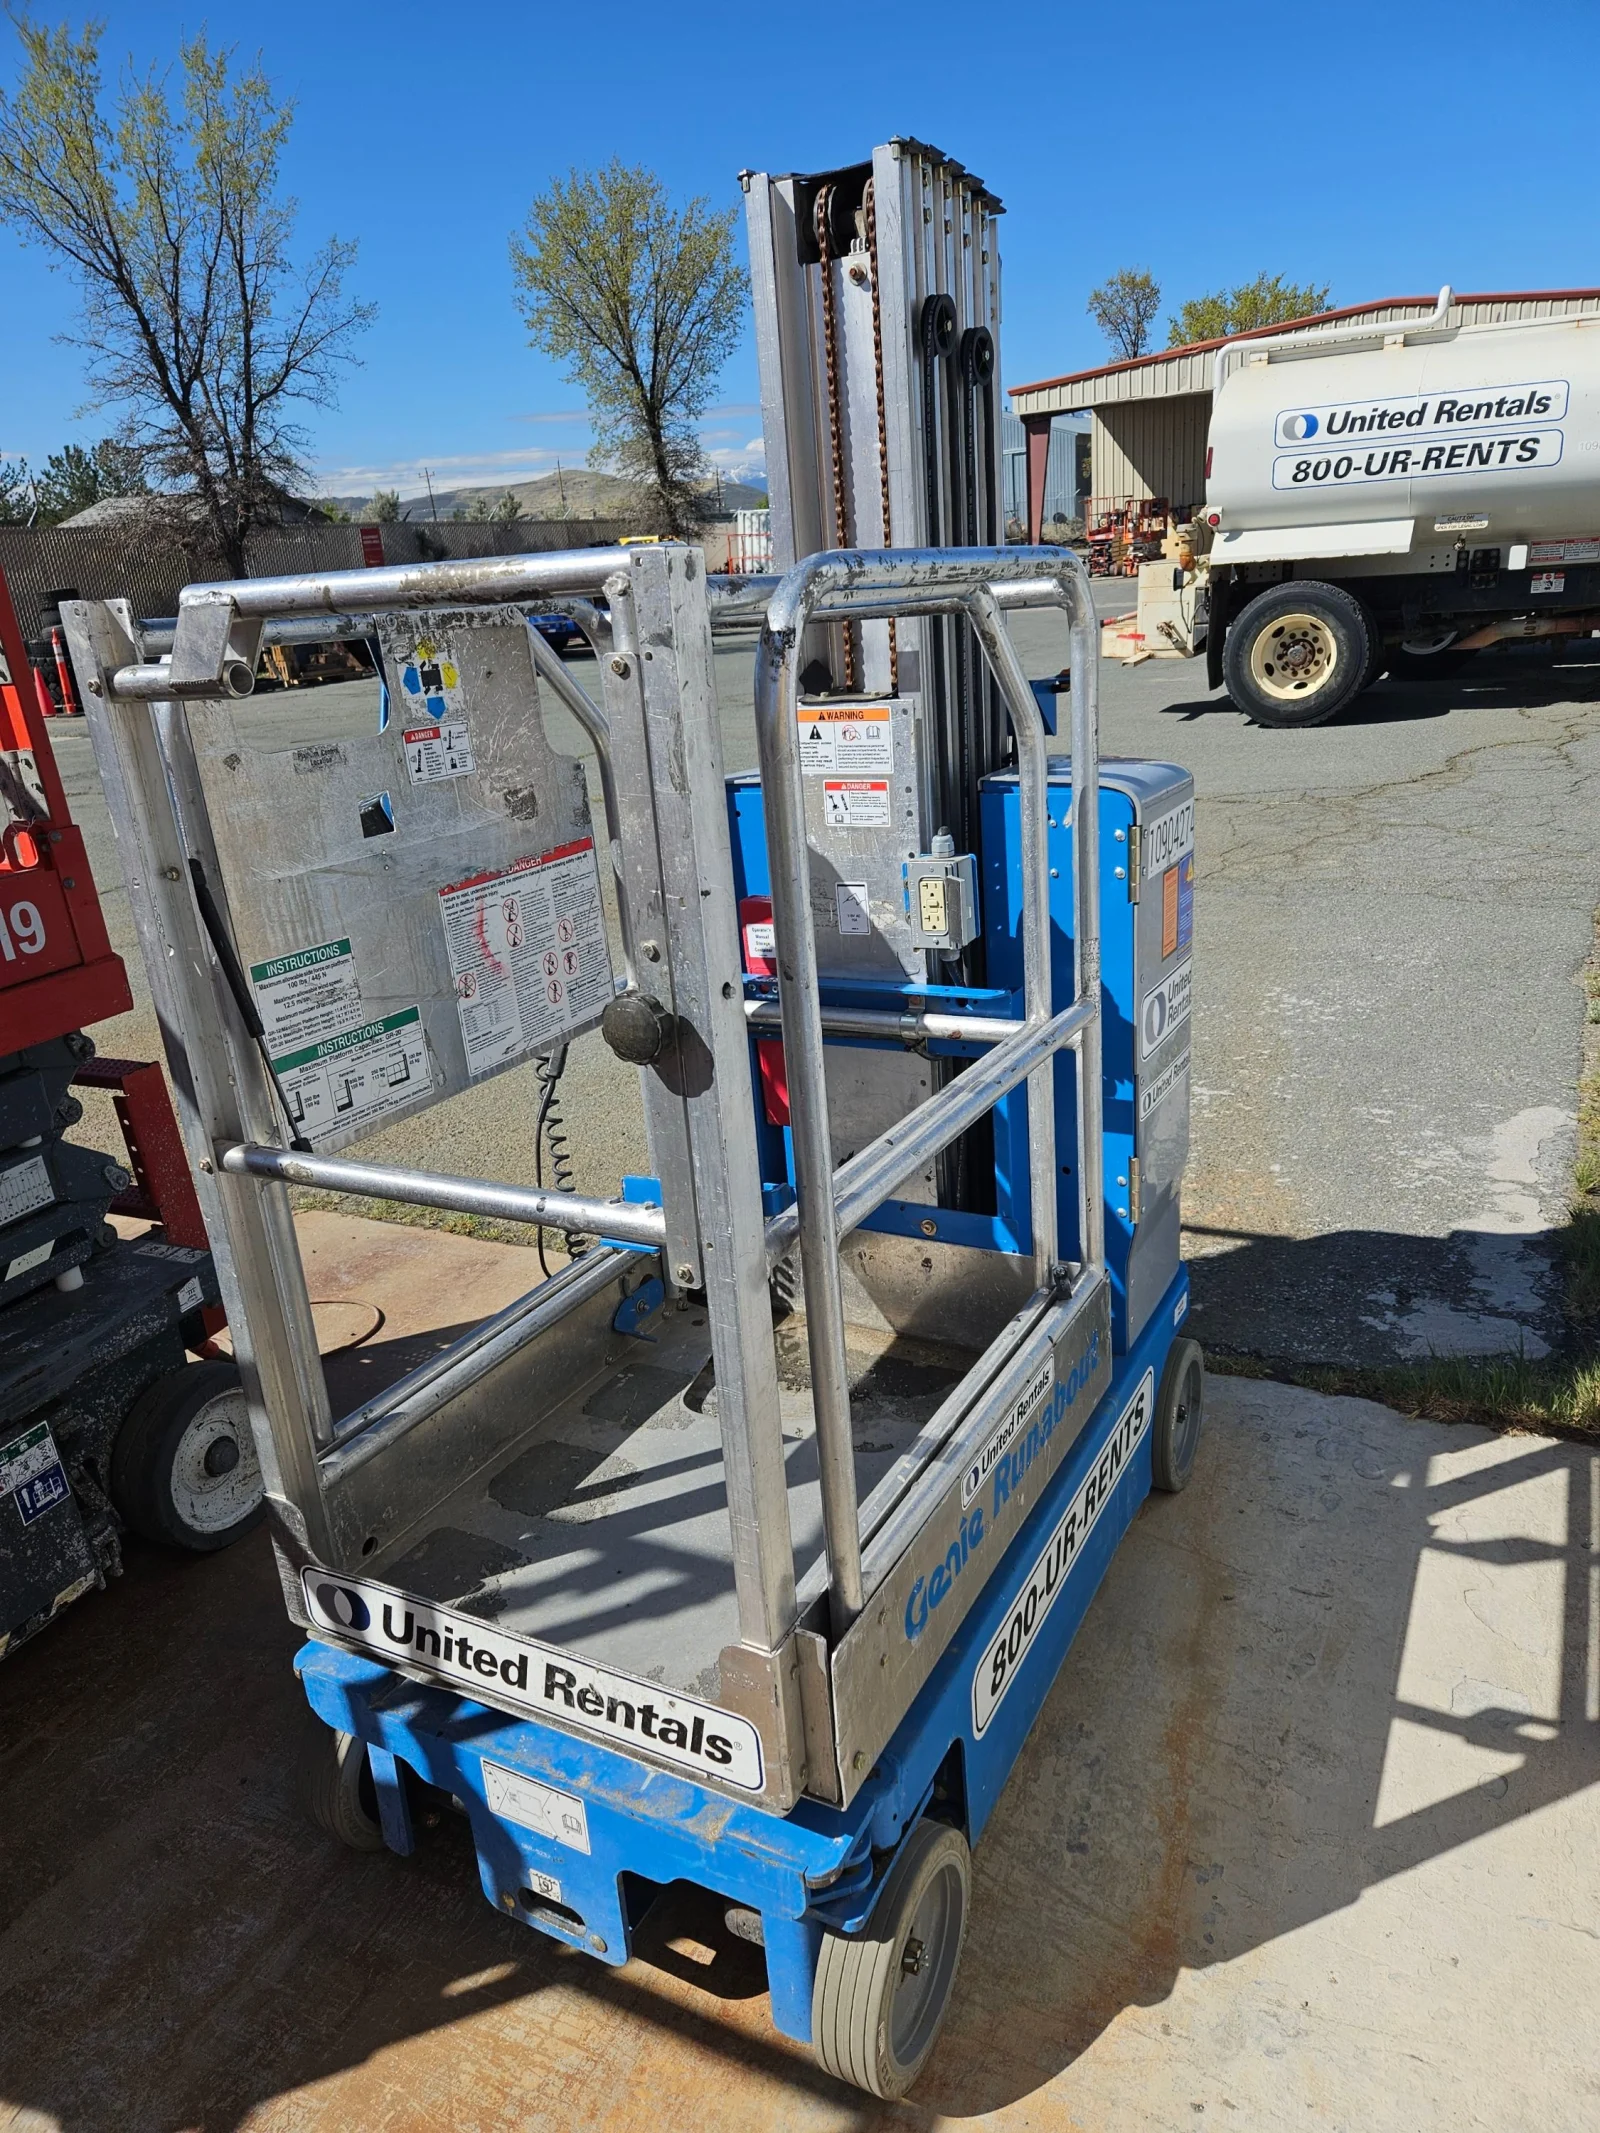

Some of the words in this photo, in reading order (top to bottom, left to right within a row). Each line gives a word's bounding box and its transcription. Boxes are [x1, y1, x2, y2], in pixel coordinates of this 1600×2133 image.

[1326, 402, 1428, 436] United
[1433, 390, 1552, 424] Rentals
[1291, 437, 1541, 483] 800-UR-RENTS
[826, 711, 864, 720] WARNING
[416, 730, 434, 740] DANGER
[508, 858, 542, 874] DANGER
[266, 944, 340, 977] INSTRUCTIONS
[259, 980, 282, 991] Maximum
[282, 972, 303, 984] allowable
[303, 969, 313, 977] side
[313, 966, 325, 974] force
[288, 981, 298, 989] 100
[299, 978, 307, 986] lbs
[312, 973, 321, 981] 445
[1168, 970, 1192, 1002] United
[274, 993, 296, 1005] Maximum
[297, 986, 318, 997] allowable
[284, 1001, 296, 1009] 12.5
[276, 1012, 298, 1023] Maximum
[299, 1006, 316, 1017] number
[299, 1058, 328, 1073] Maximum
[329, 1049, 353, 1062] Platform
[354, 1038, 384, 1052] Capacities:
[385, 1029, 402, 1040] GR-20
[317, 1022, 384, 1056] INSTRUCTIONS
[286, 1084, 302, 1092] Platform
[1152, 1070, 1172, 1103] United
[333, 1116, 351, 1126] Maximum
[981, 1420, 1014, 1476] United
[1016, 1370, 1050, 1420] Rentals
[904, 1507, 984, 1642] Genie
[993, 1331, 1100, 1519] Runabout
[990, 1392, 1144, 1698] 800-UR-RENTS
[382, 1603, 529, 1690] United
[543, 1662, 733, 1766] Rentals
